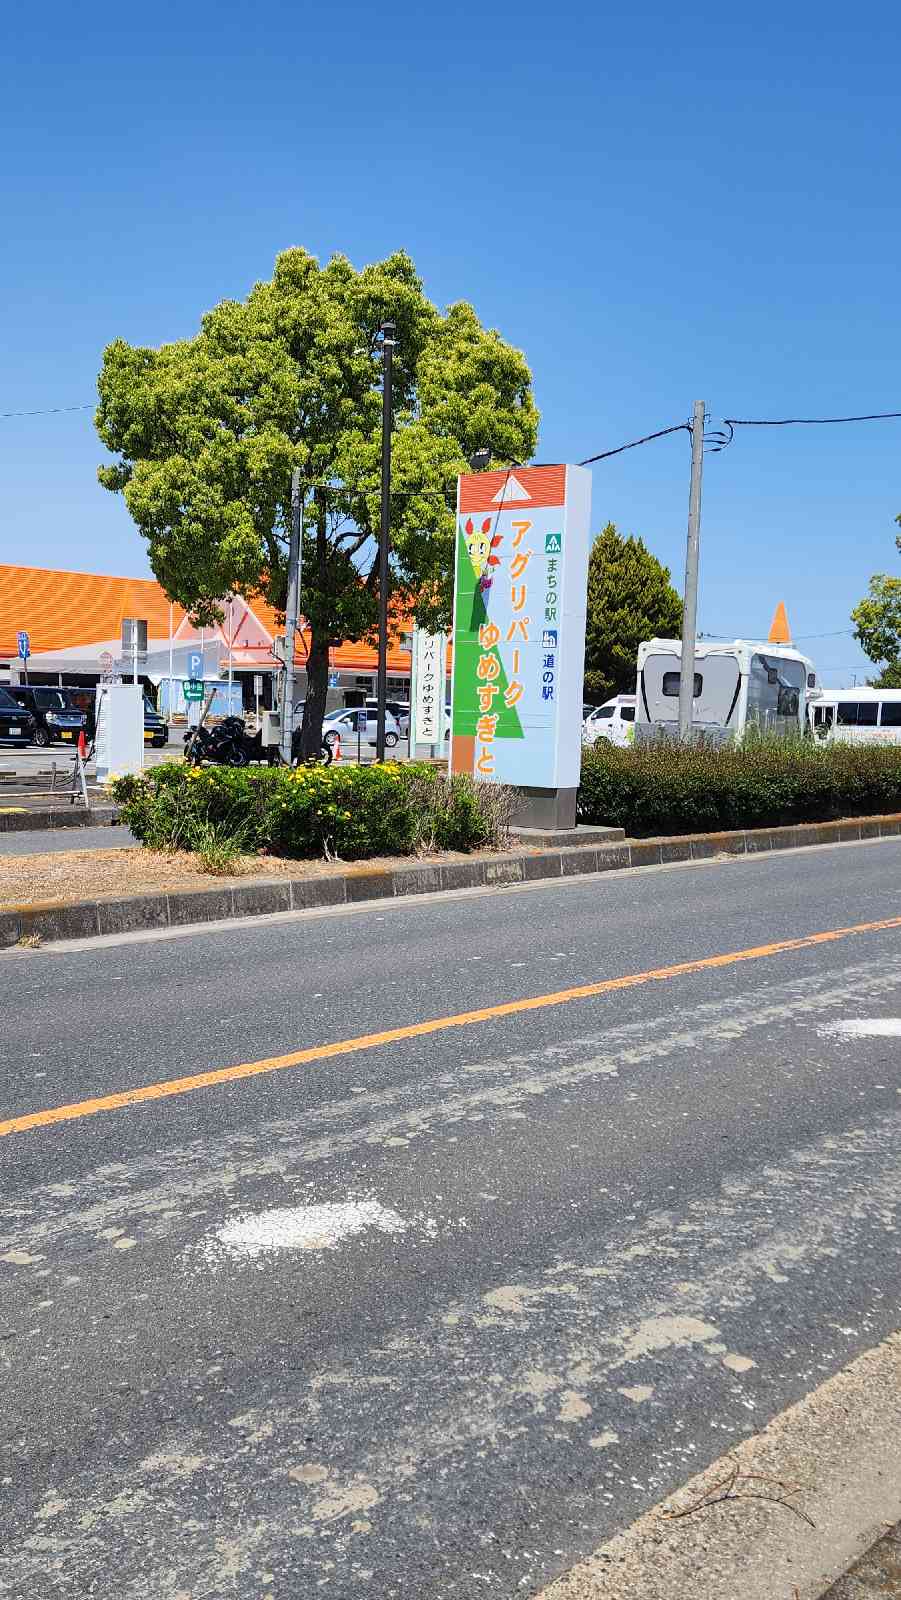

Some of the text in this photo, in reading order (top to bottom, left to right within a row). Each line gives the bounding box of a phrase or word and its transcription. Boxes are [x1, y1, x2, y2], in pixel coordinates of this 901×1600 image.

[504, 520, 534, 708] アグリパーク
[545, 559, 558, 621] まちの駅
[191, 655, 201, 670] P
[542, 654, 556, 700] 道の駅
[476, 623, 500, 774] ゆめすぎと
